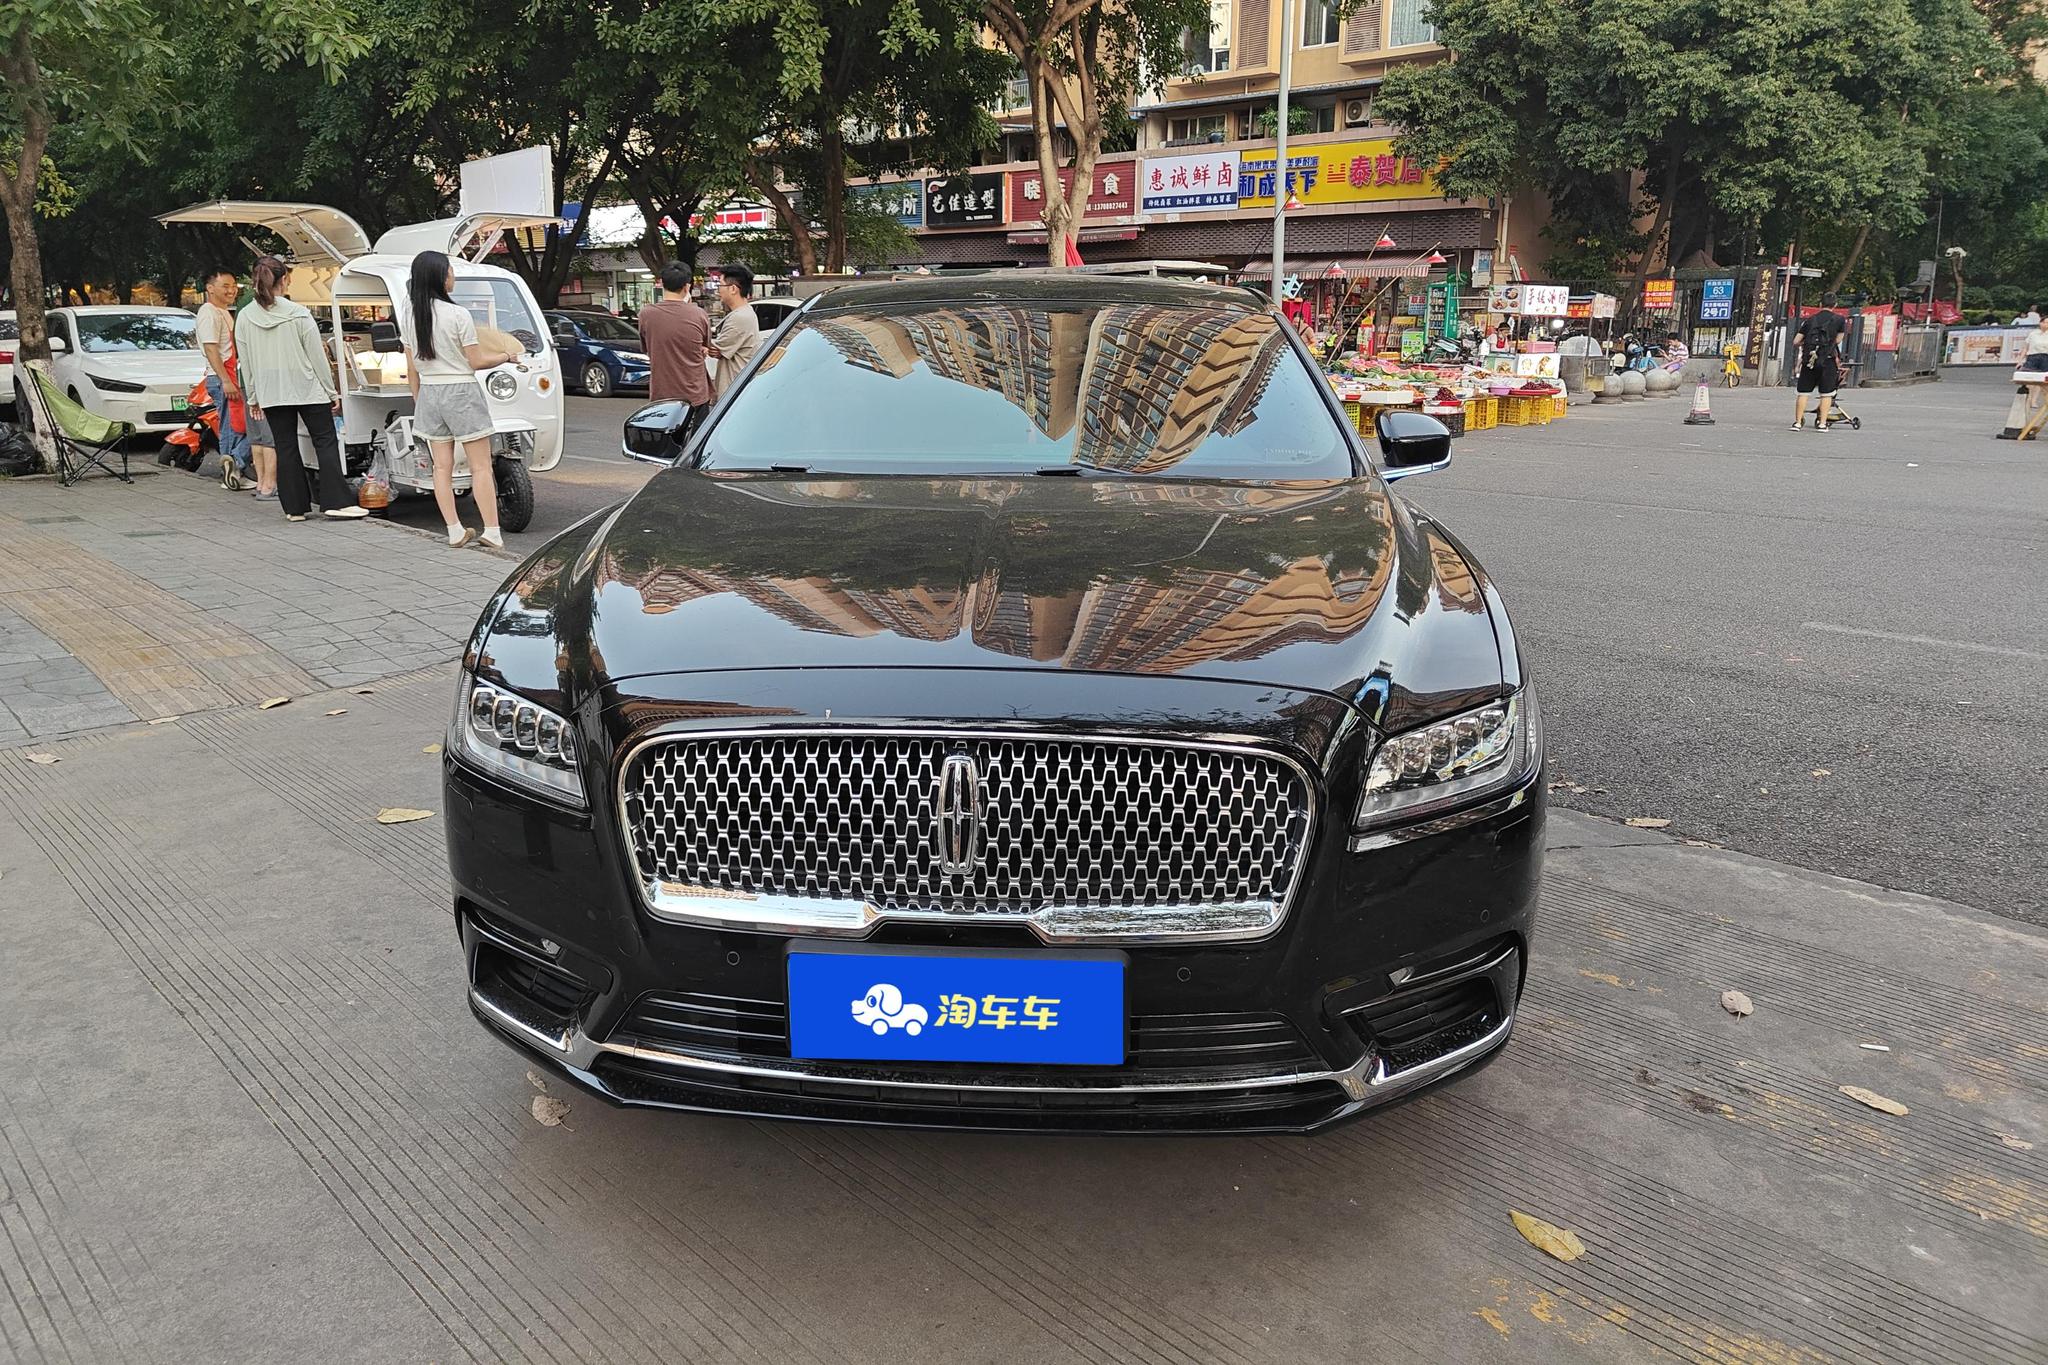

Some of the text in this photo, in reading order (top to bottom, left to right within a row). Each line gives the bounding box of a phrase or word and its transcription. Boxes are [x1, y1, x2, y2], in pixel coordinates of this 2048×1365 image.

[1149, 161, 1233, 191] 惠诚鲜卤
[932, 188, 996, 213] 艺佳造型
[1713, 286, 1724, 295] 63
[1704, 307, 1728, 317] 2号门
